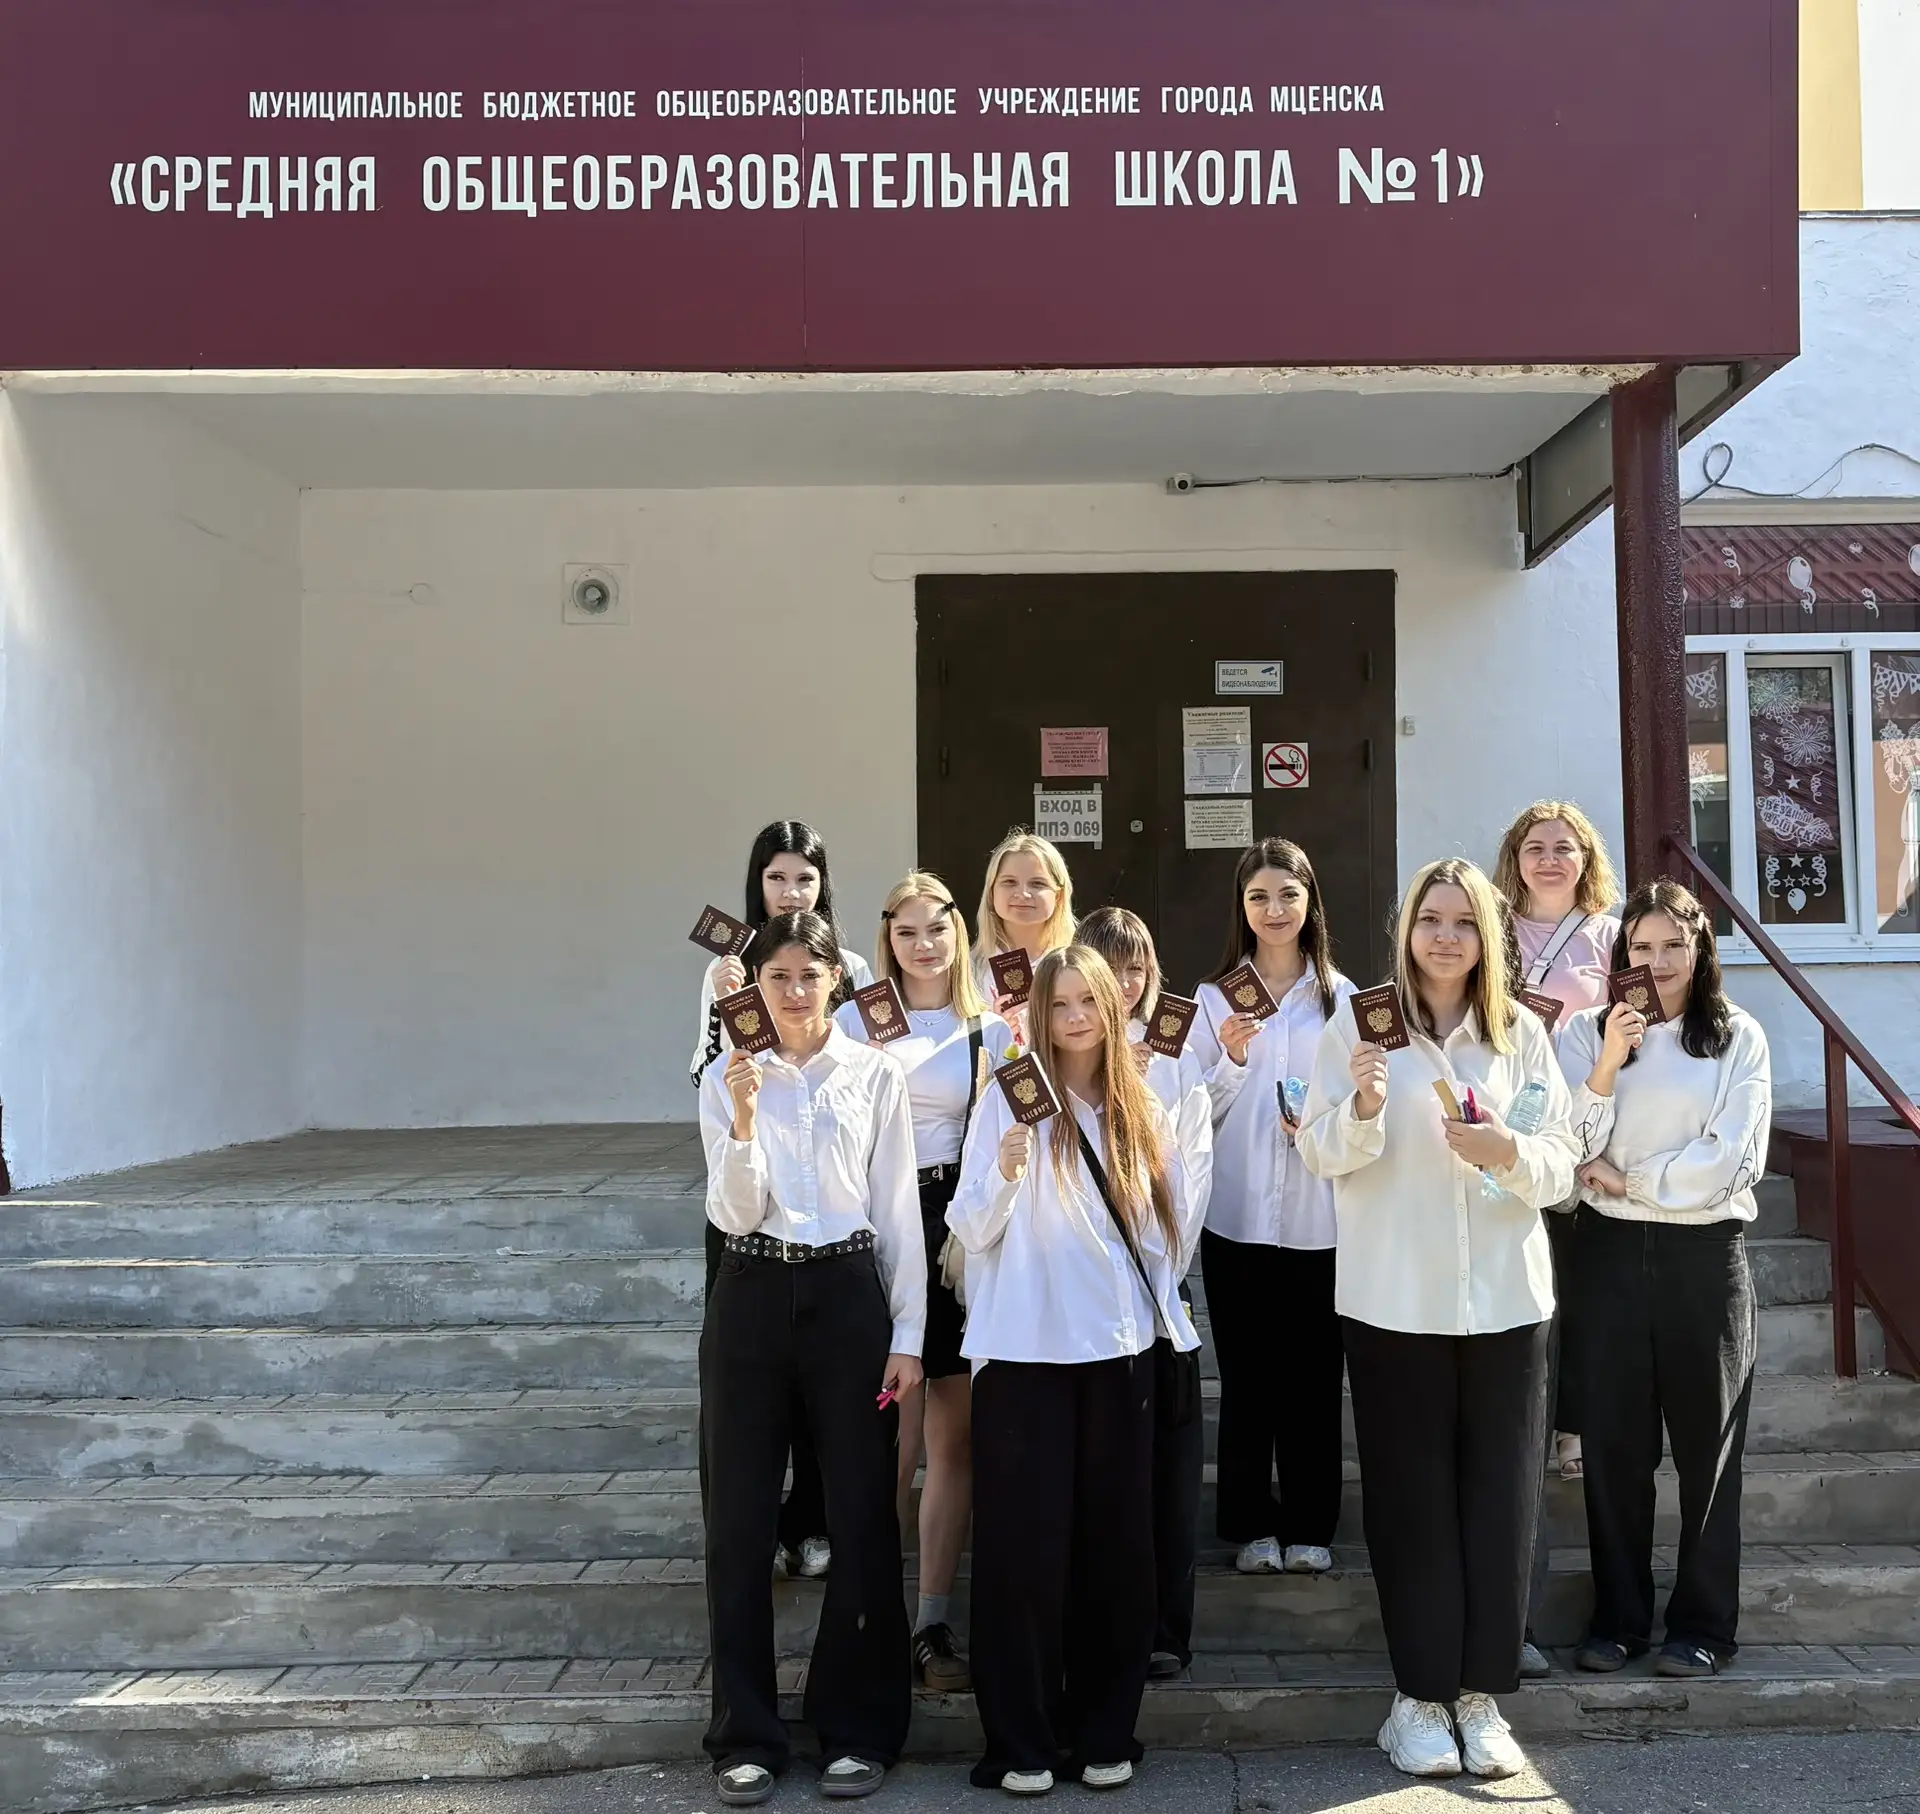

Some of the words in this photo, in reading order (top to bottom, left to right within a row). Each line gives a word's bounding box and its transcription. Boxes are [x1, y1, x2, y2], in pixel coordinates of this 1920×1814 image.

[249, 91, 463, 122] МУНИЦИПАЛЬНОЕ
[483, 90, 636, 121] БЮДЖЕТНОЕ
[656, 88, 957, 119] ОБЩЕОБРАЗОВАТЕЛЬНОЕ
[978, 86, 1141, 117] УЧРЕЖДЕНИЕ
[1161, 86, 1254, 116] ГОРОДА
[1270, 84, 1385, 116] МЦЕНСКА
[110, 155, 376, 219] «СРЕДНЯЯ
[422, 150, 1070, 217] ОБЩЕОБРАЗОВАТЕЛЬНАЯ
[1115, 149, 1298, 207] ШКОЛА
[1222, 668, 1248, 676] ВЕДЕТСЯ
[1222, 680, 1278, 688] ВИДЕОНАБЛЮДЕНИЕ
[1039, 799, 1083, 815] ВХОД
[1087, 799, 1097, 812] В
[1037, 821, 1070, 837] ППЭ
[1073, 820, 1100, 837] 069
[729, 929, 747, 955] ПАСПОРТ
[875, 1024, 903, 1040] ПАСПОРТ
[1149, 1038, 1176, 1052] ПАСПОРТ
[1021, 1102, 1050, 1122] ПАСПОРТ
